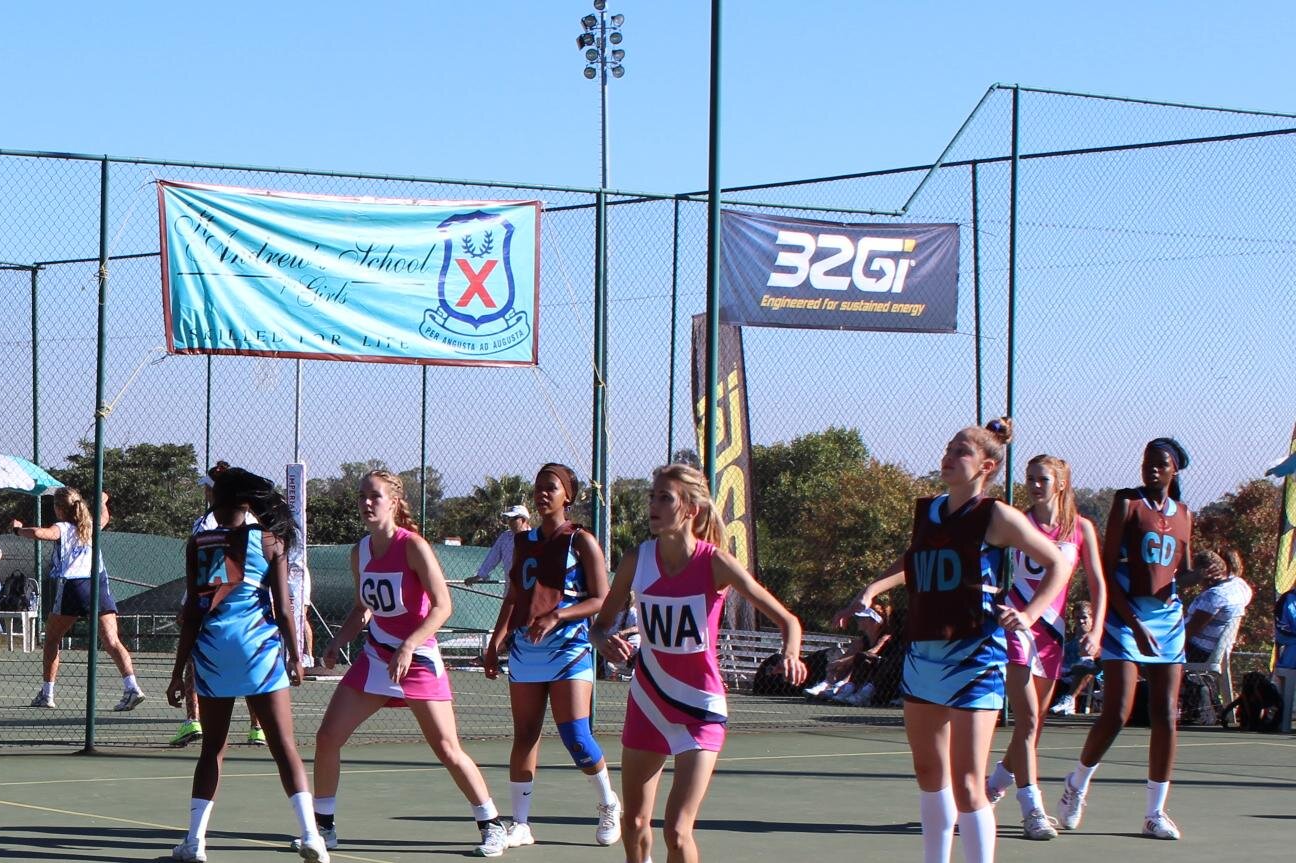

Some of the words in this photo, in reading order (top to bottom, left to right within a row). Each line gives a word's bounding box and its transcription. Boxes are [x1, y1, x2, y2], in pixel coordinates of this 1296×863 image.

[338, 242, 436, 274] School
[766, 230, 917, 294] 32Gi
[297, 275, 349, 307] Girls
[760, 294, 821, 311] Engineered
[822, 298, 839, 311] for
[840, 300, 891, 313] sustained
[891, 303, 926, 317] energy
[425, 326, 440, 340] PER
[479, 342, 489, 351] AD
[493, 329, 524, 349] AUGUSTA
[1141, 531, 1176, 567] GD
[196, 547, 229, 586] GA
[522, 557, 538, 590] C
[913, 548, 962, 593] WD
[640, 602, 703, 647] WA
